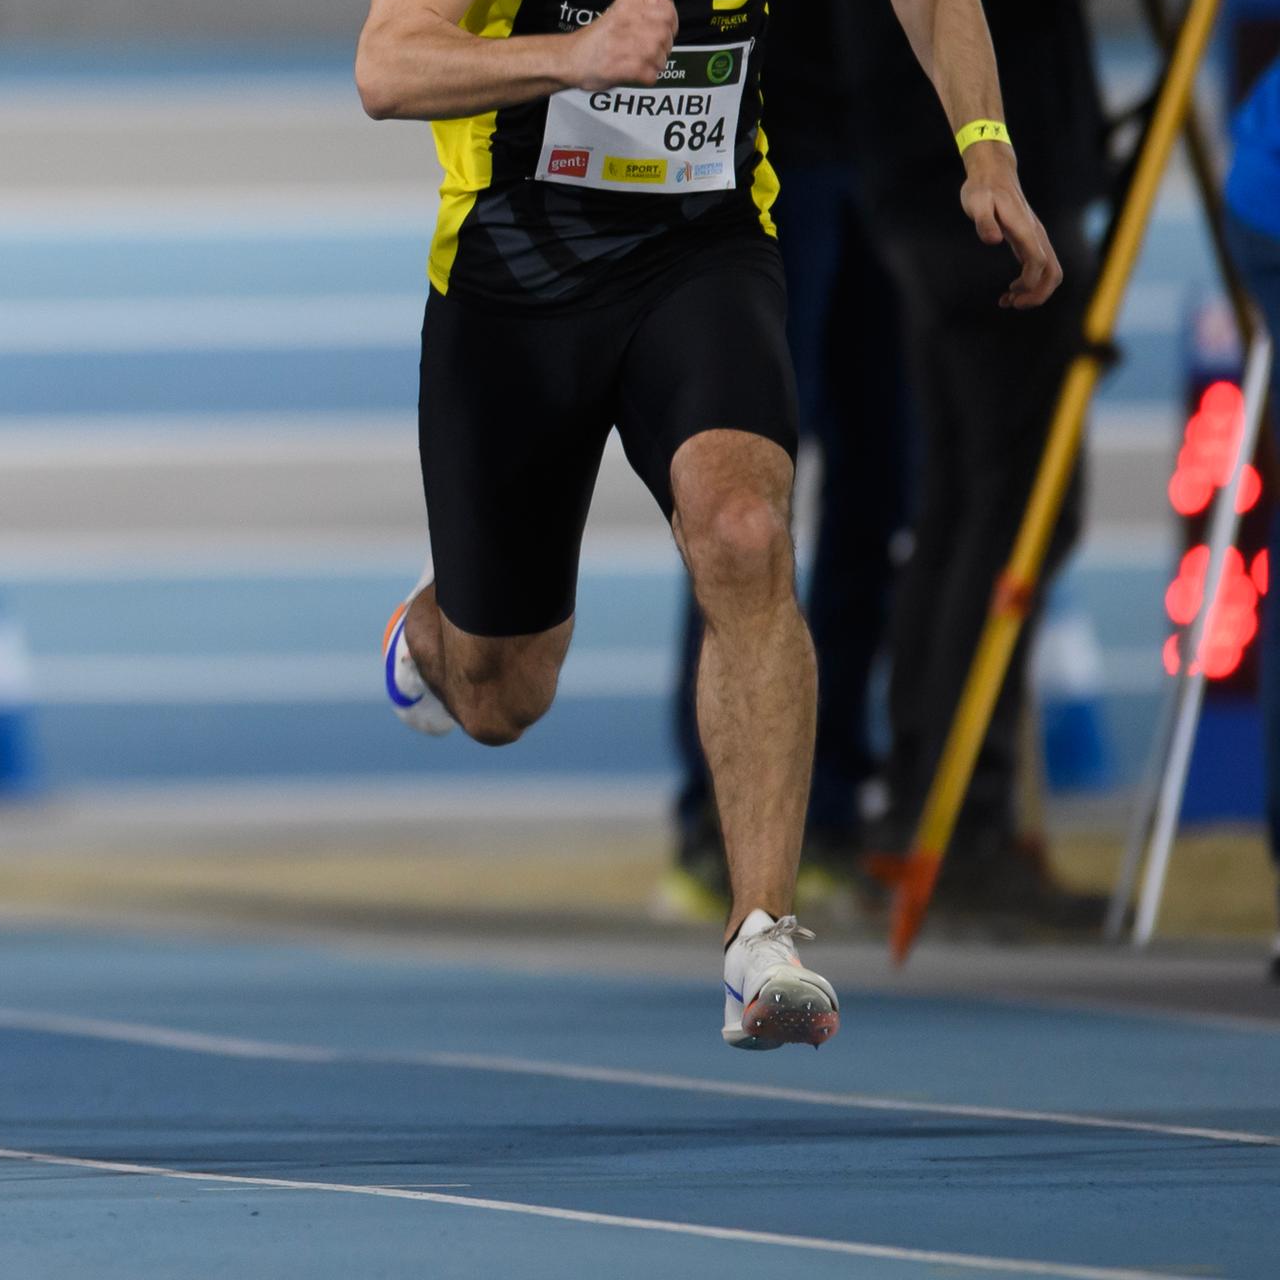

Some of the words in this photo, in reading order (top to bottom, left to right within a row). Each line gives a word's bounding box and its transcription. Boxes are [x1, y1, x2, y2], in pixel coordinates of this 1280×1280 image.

[590, 92, 712, 116] GHRAIBI
[664, 117, 725, 152] 684
[551, 155, 586, 171] gent:
[626, 164, 660, 173] SPORT
